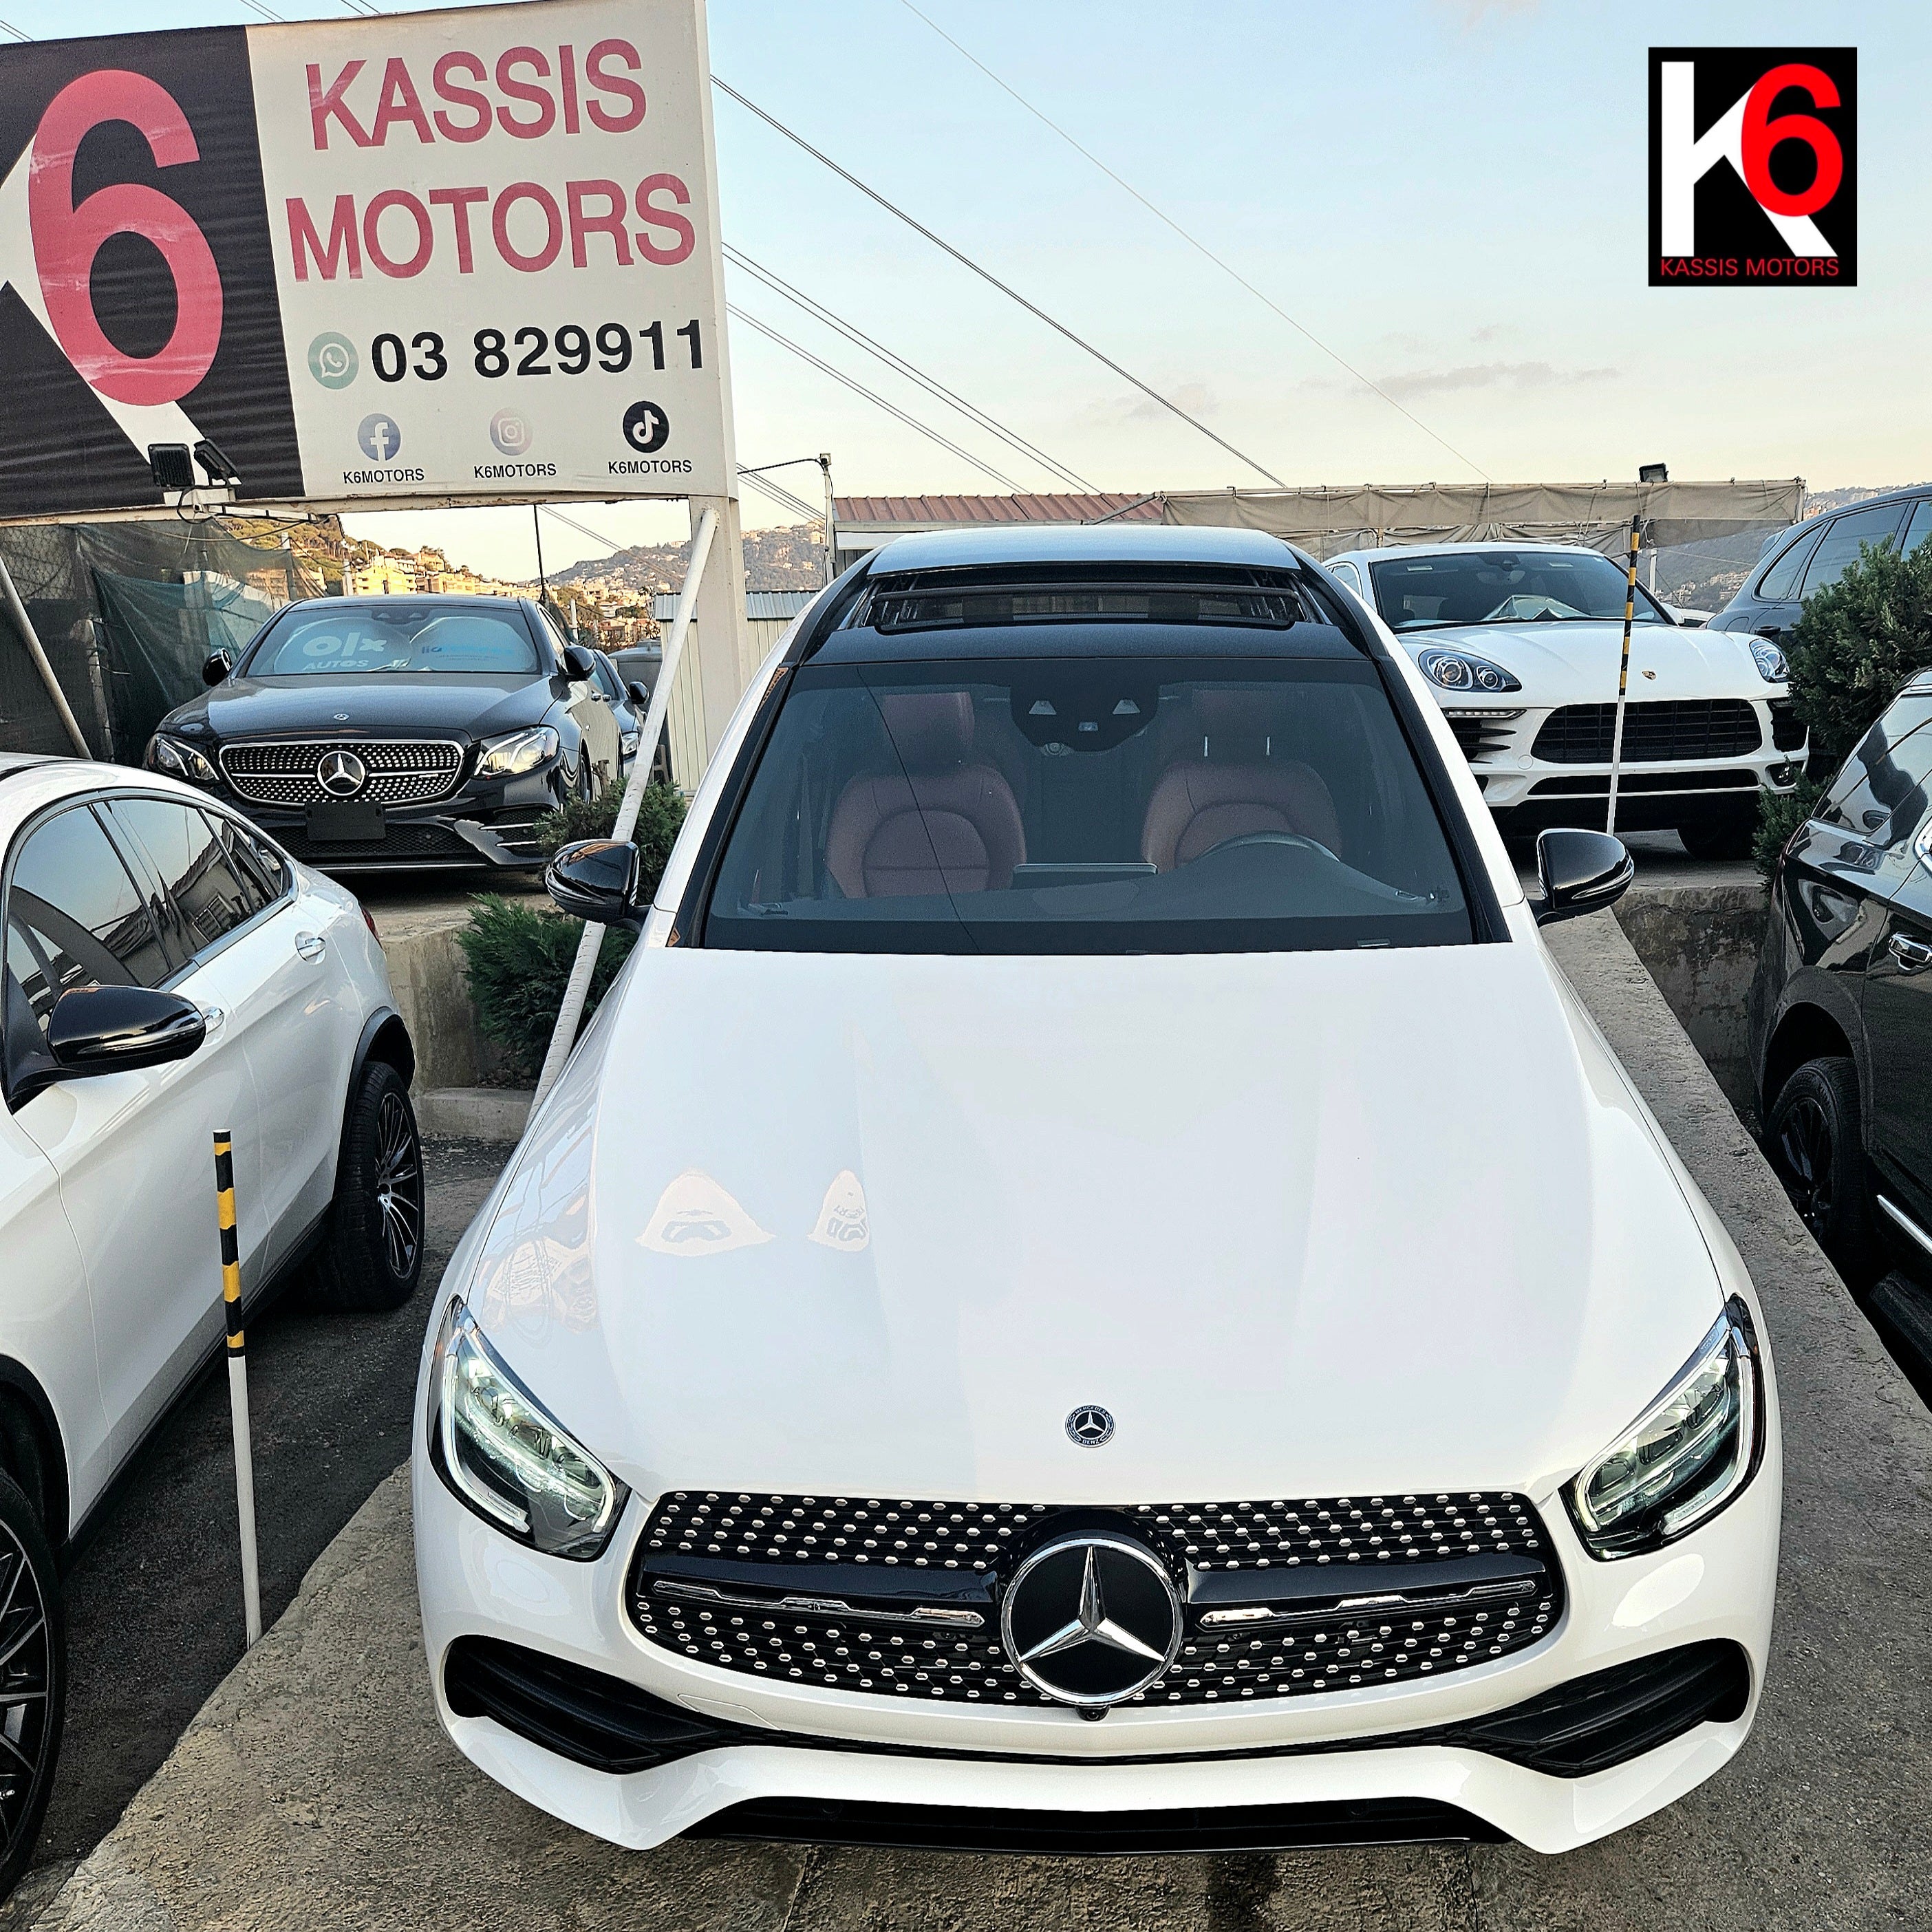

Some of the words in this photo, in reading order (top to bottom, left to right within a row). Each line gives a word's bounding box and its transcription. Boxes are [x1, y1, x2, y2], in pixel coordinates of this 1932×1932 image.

[306, 39, 646, 150] KASSIS
[286, 173, 695, 281] MOTORS
[372, 332, 448, 383] 03
[473, 319, 703, 378] 829911
[473, 463, 557, 479] K6MOTORS
[608, 460, 692, 474] K6MOTORS
[343, 468, 425, 484] K6MOTORS
[303, 659, 369, 671] AUTOS
